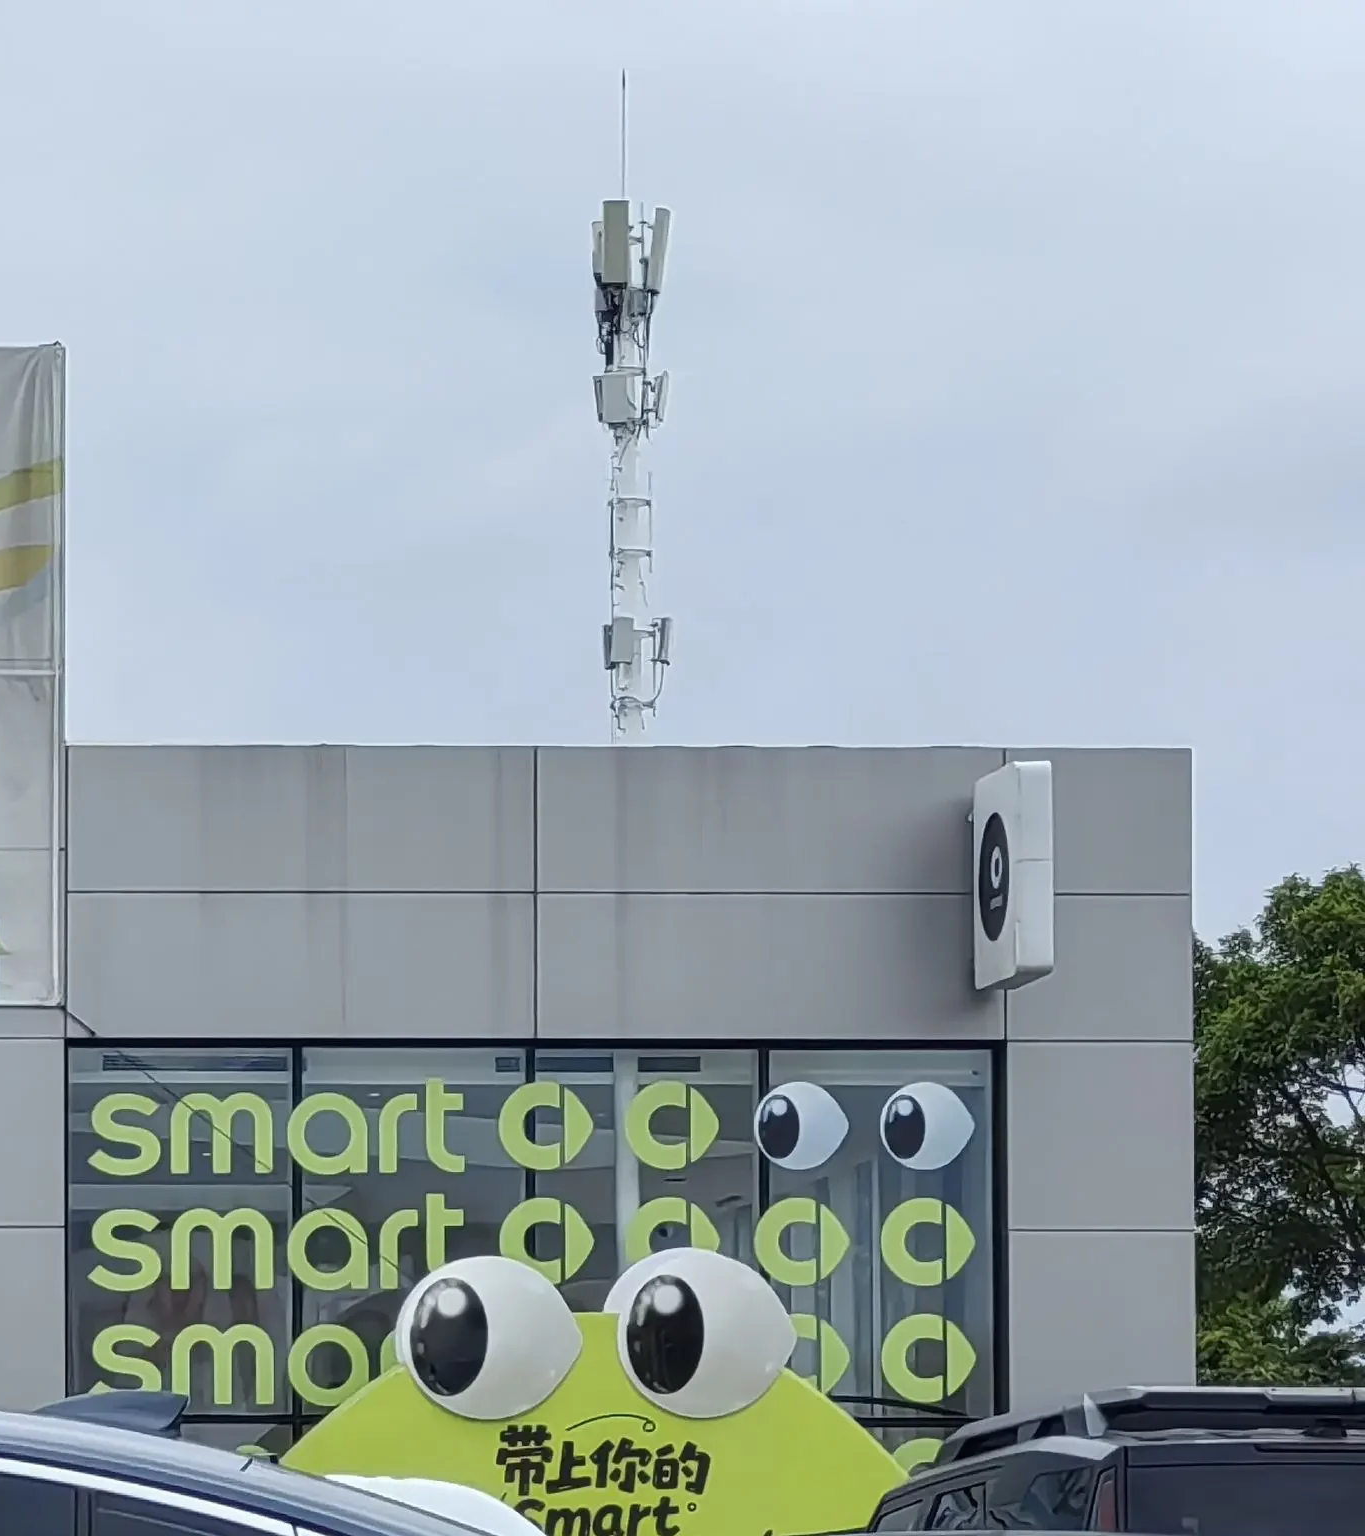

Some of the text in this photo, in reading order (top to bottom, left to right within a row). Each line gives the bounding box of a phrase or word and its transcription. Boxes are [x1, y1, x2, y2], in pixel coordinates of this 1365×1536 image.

[87, 1077, 466, 1176] smart
[87, 1192, 465, 1292] smart
[89, 1324, 397, 1406] sma
[495, 1424, 711, 1496] 带上你的
